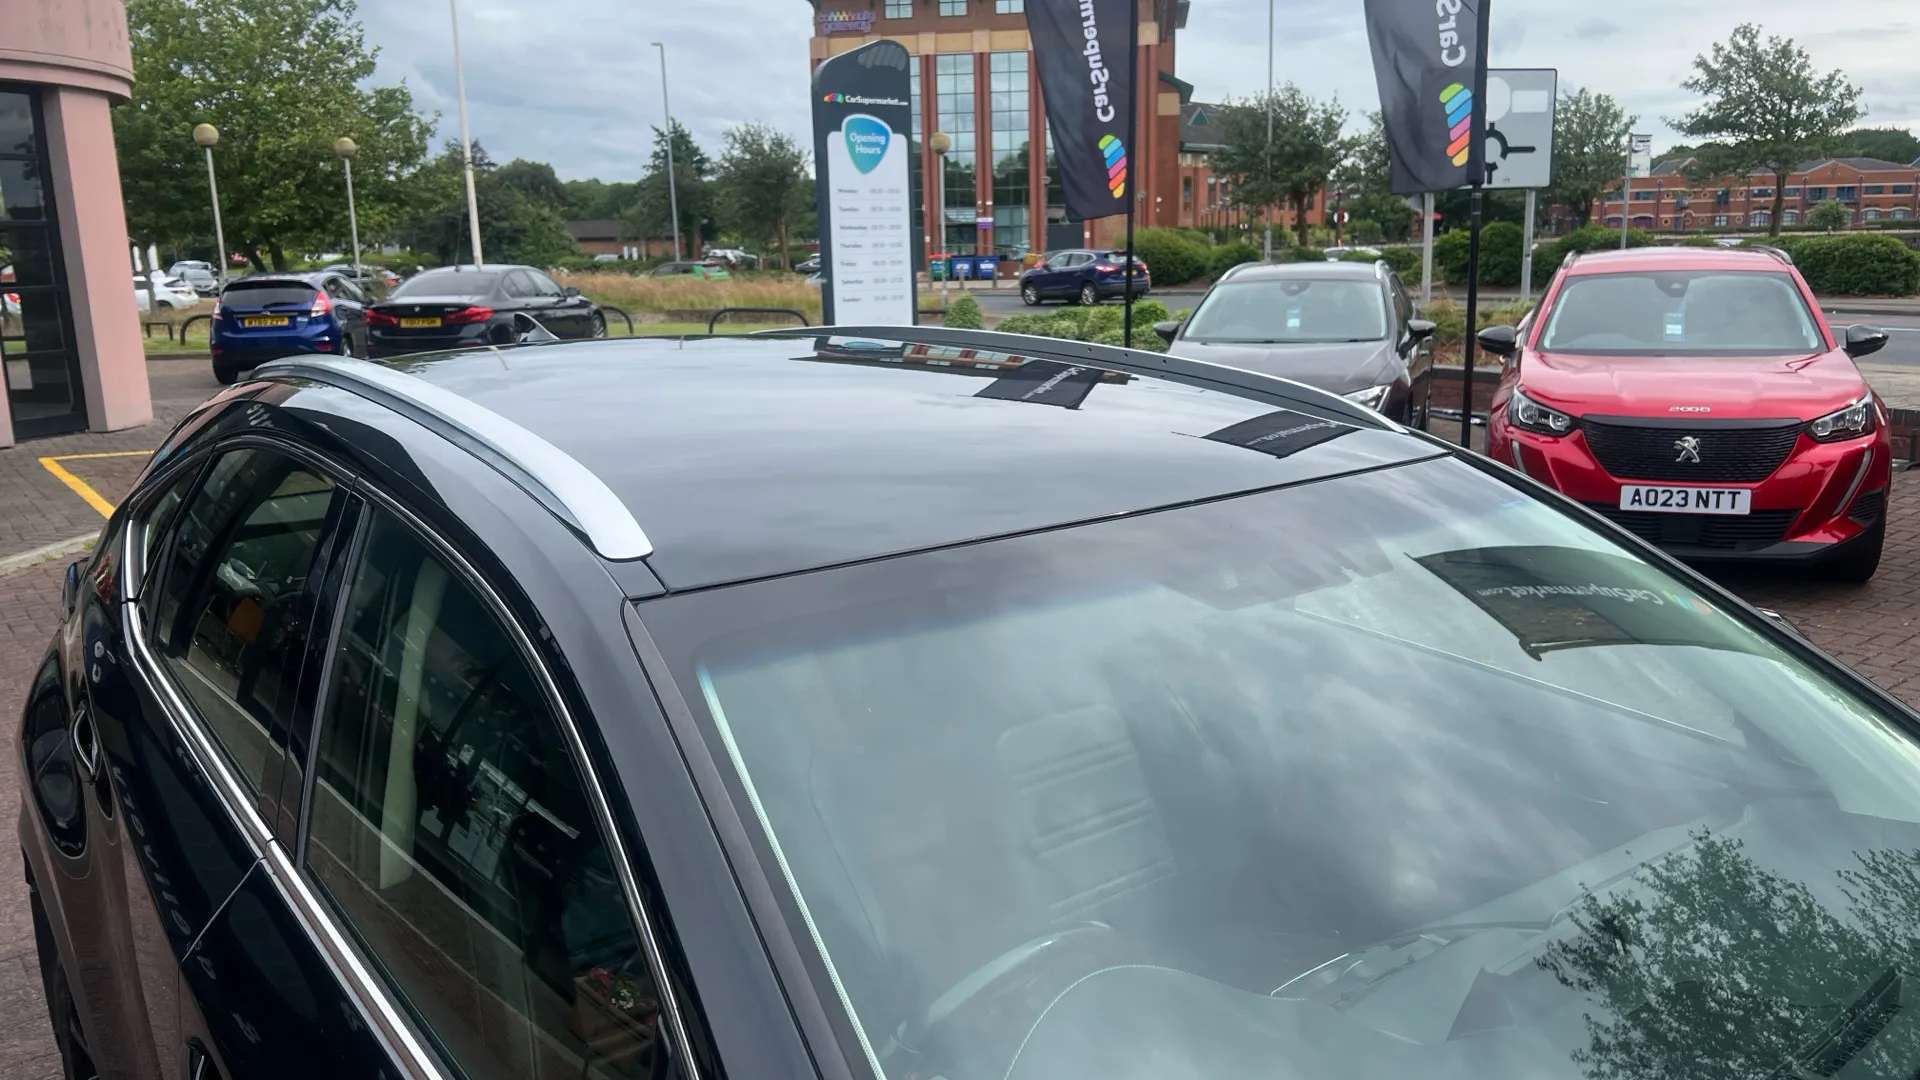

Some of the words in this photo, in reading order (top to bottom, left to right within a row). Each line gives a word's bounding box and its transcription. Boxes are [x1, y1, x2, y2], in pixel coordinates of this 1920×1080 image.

[849, 132, 886, 145] Opening
[855, 144, 882, 154] Hours
[1695, 490, 1741, 510] NTT
